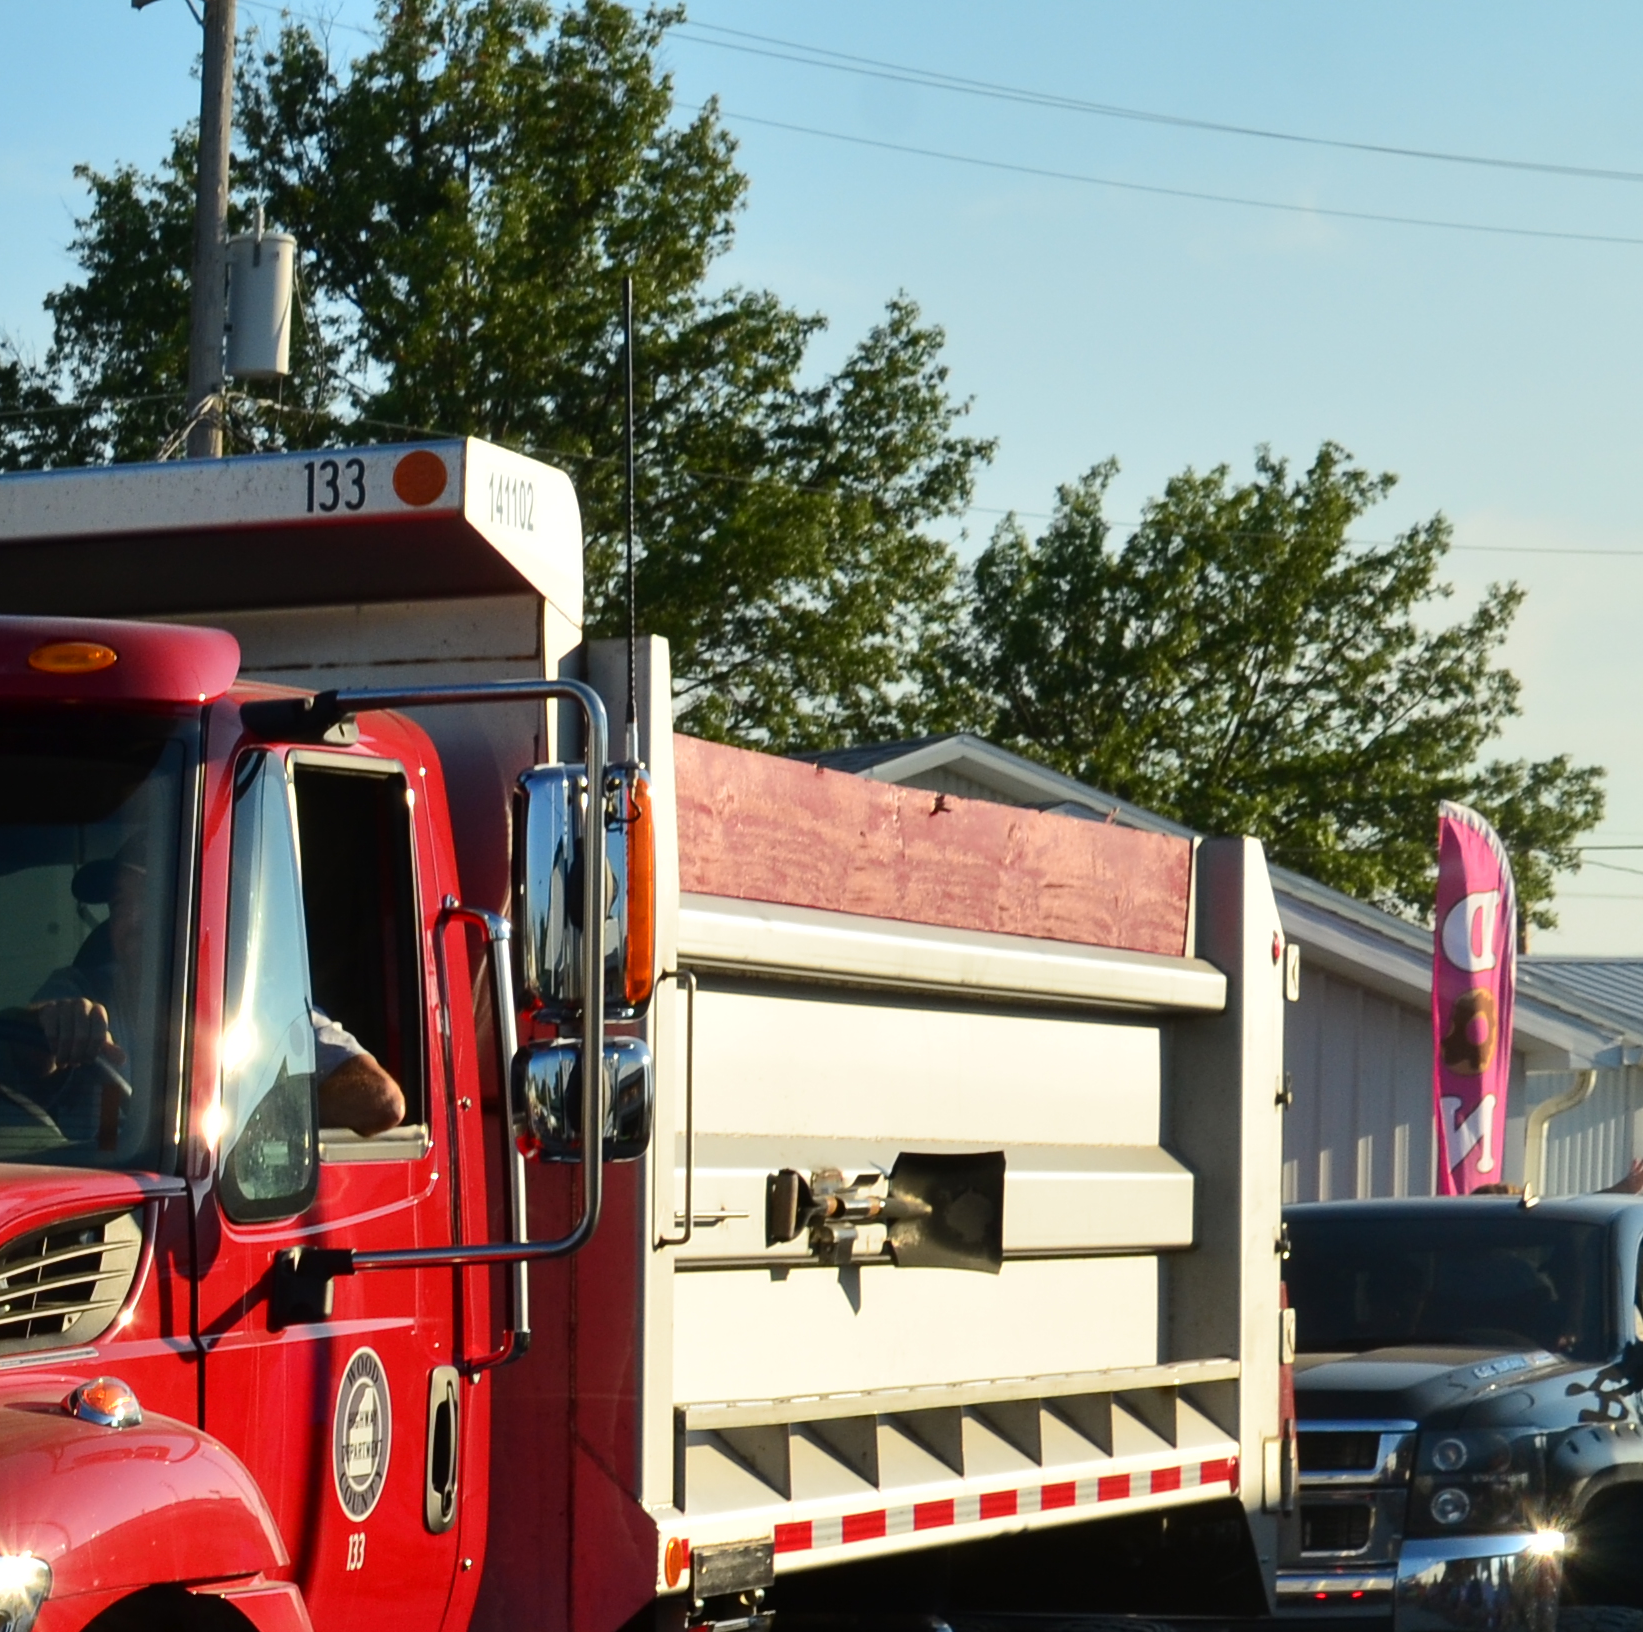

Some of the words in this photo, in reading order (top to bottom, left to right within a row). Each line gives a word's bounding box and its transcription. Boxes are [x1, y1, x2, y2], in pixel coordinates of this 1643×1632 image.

[303, 457, 366, 514] 133
[488, 471, 535, 532] 141102
[347, 1355, 380, 1388] WOOD
[346, 1532, 366, 1571] 133
